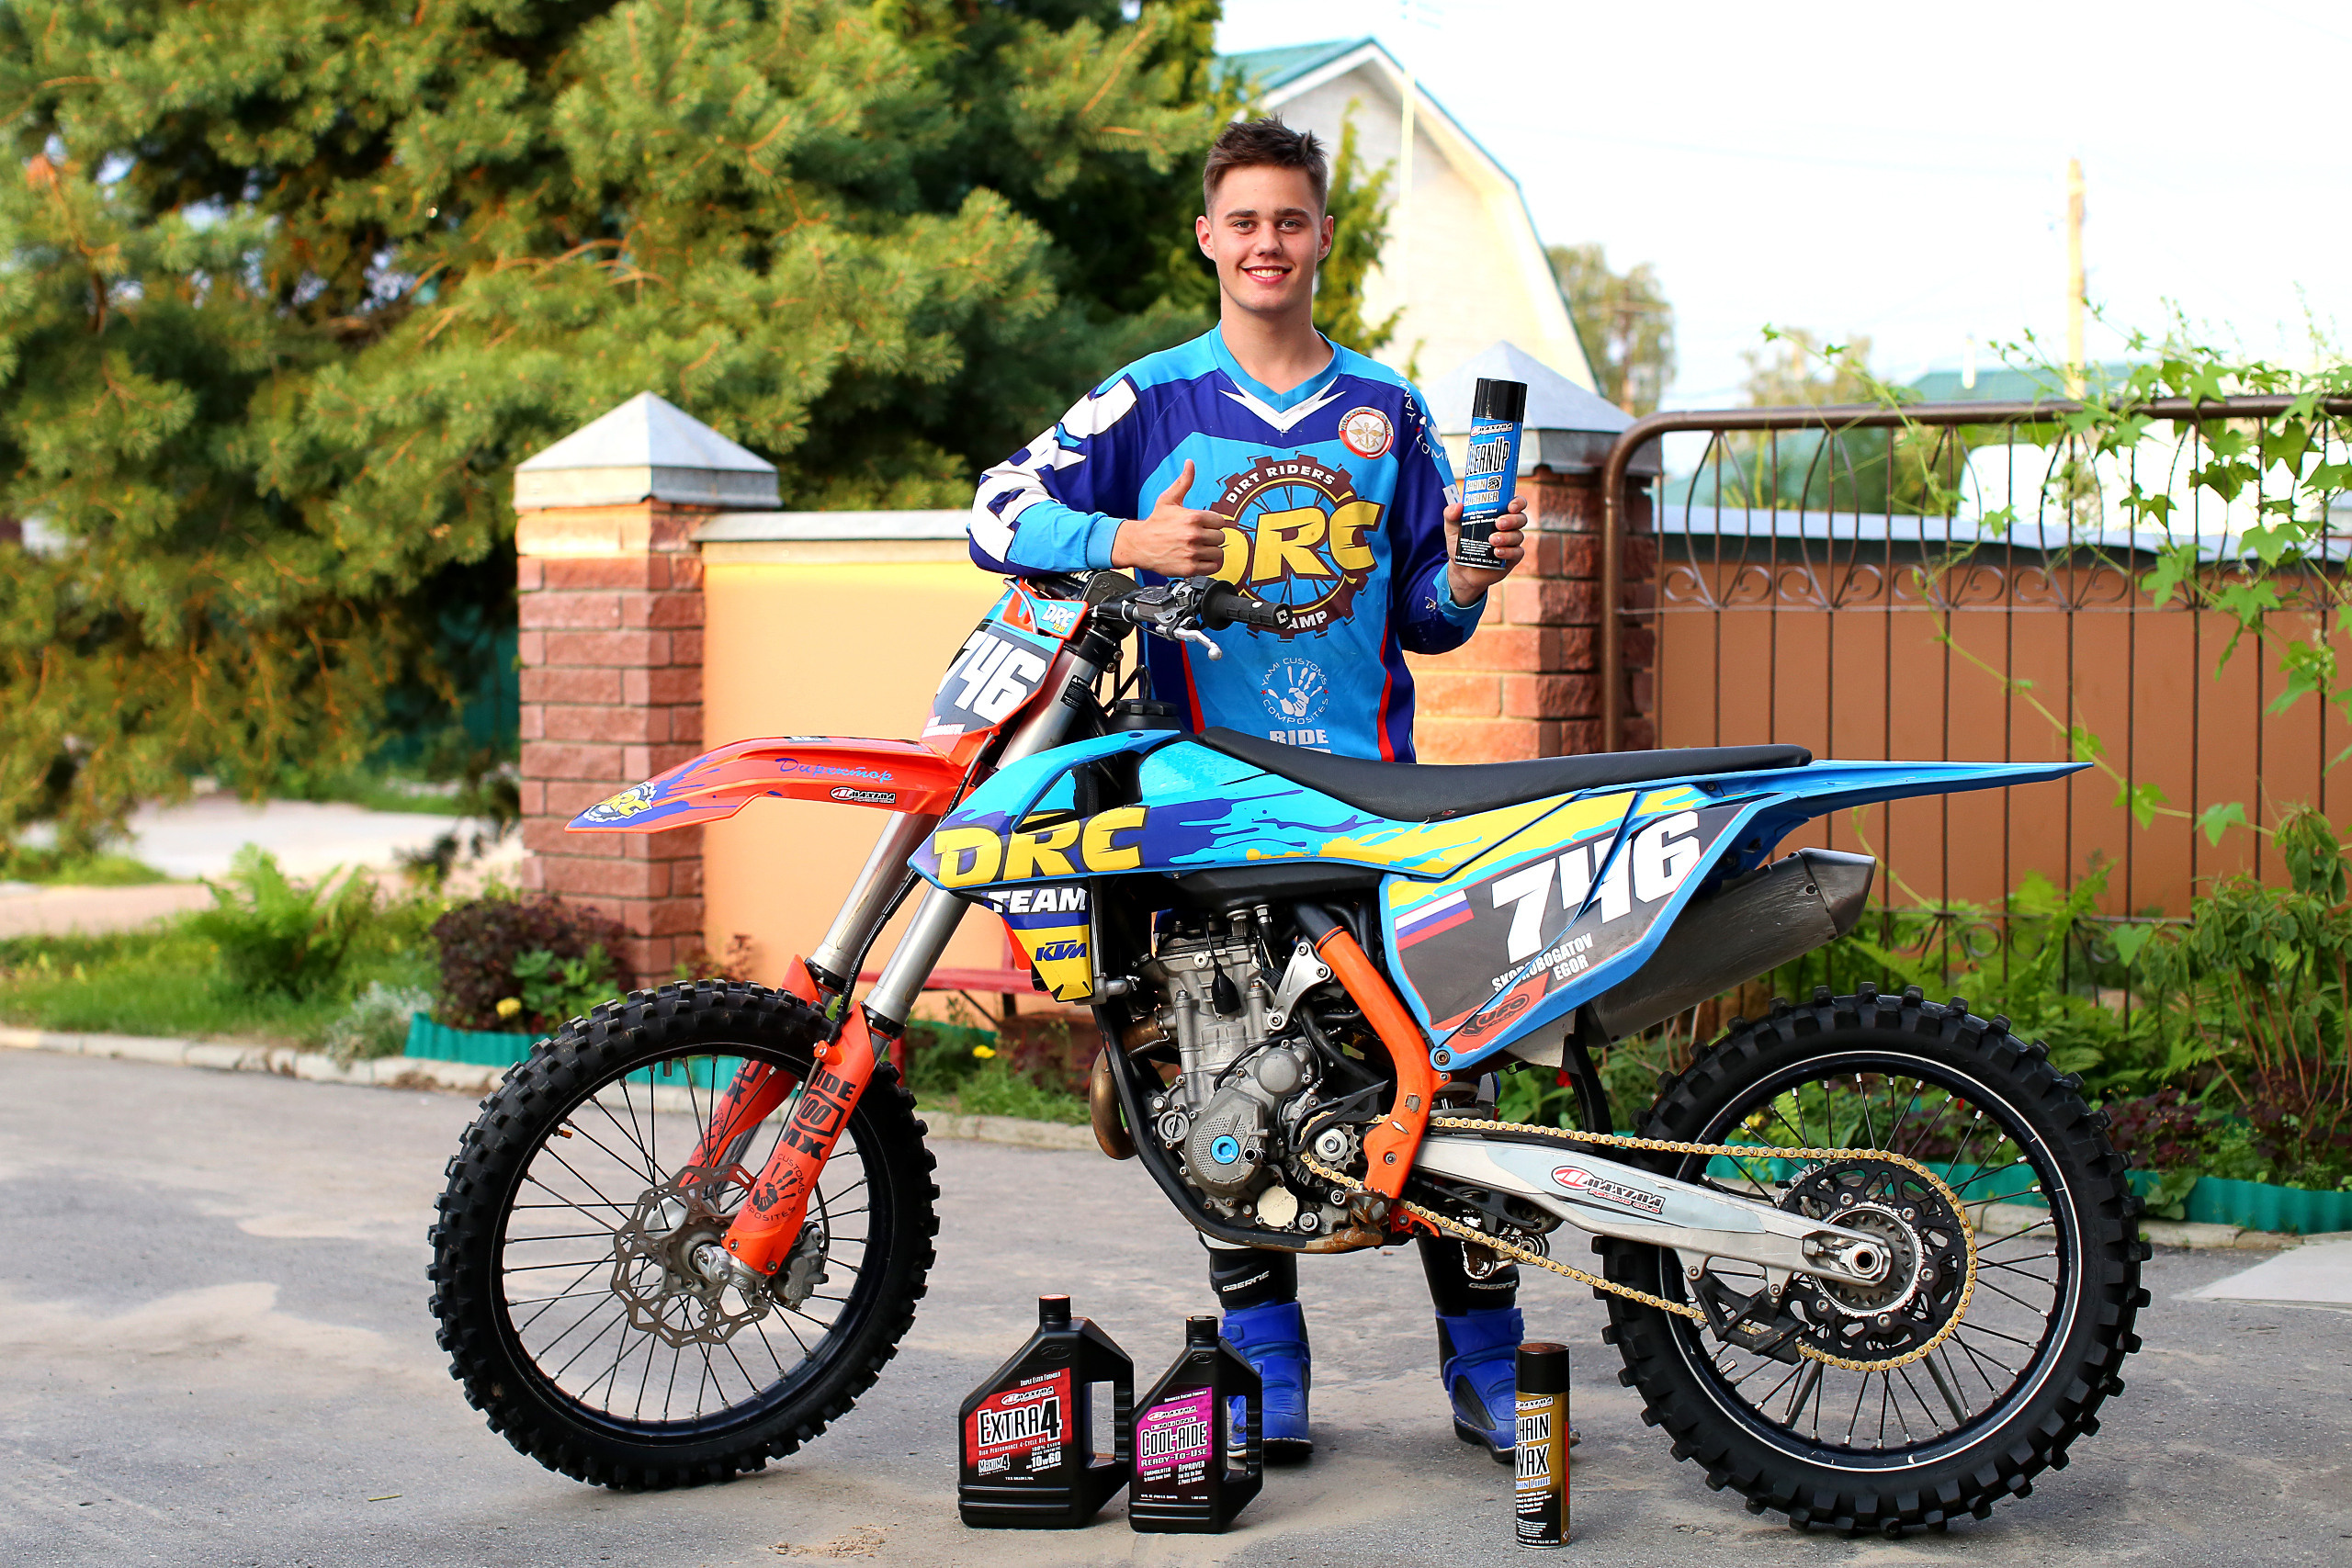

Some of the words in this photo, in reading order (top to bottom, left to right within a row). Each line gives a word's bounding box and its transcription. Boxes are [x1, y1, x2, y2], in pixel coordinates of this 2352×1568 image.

[1226, 472, 1260, 503] DIRT
[1265, 464, 1336, 485] RIDERS
[1206, 501, 1381, 586] DRC
[1042, 603, 1077, 628] DRC
[936, 630, 1046, 724] 746
[1261, 661, 1281, 686] YAMI
[1283, 658, 1328, 685] CUSTOMS
[1262, 698, 1329, 725] COMPOSITES
[1270, 729, 1329, 746] RIDE
[775, 758, 894, 784] Директор
[933, 805, 1150, 888] DRC
[988, 887, 1088, 914] TEAM
[1491, 809, 1701, 964] 746
[1035, 939, 1087, 962] KTM
[1552, 953, 1590, 981] EGOR
[776, 1153, 806, 1194] CUSTOMS
[1582, 1178, 1666, 1210] MAXIMA
[1222, 1270, 1270, 1292] GAERNE
[1140, 1420, 1208, 1459] COOL-AIDE
[1140, 1448, 1207, 1467] READY-TO-USE
[1178, 1460, 1205, 1473] APPROVED
[1515, 1442, 1551, 1479] WAX
